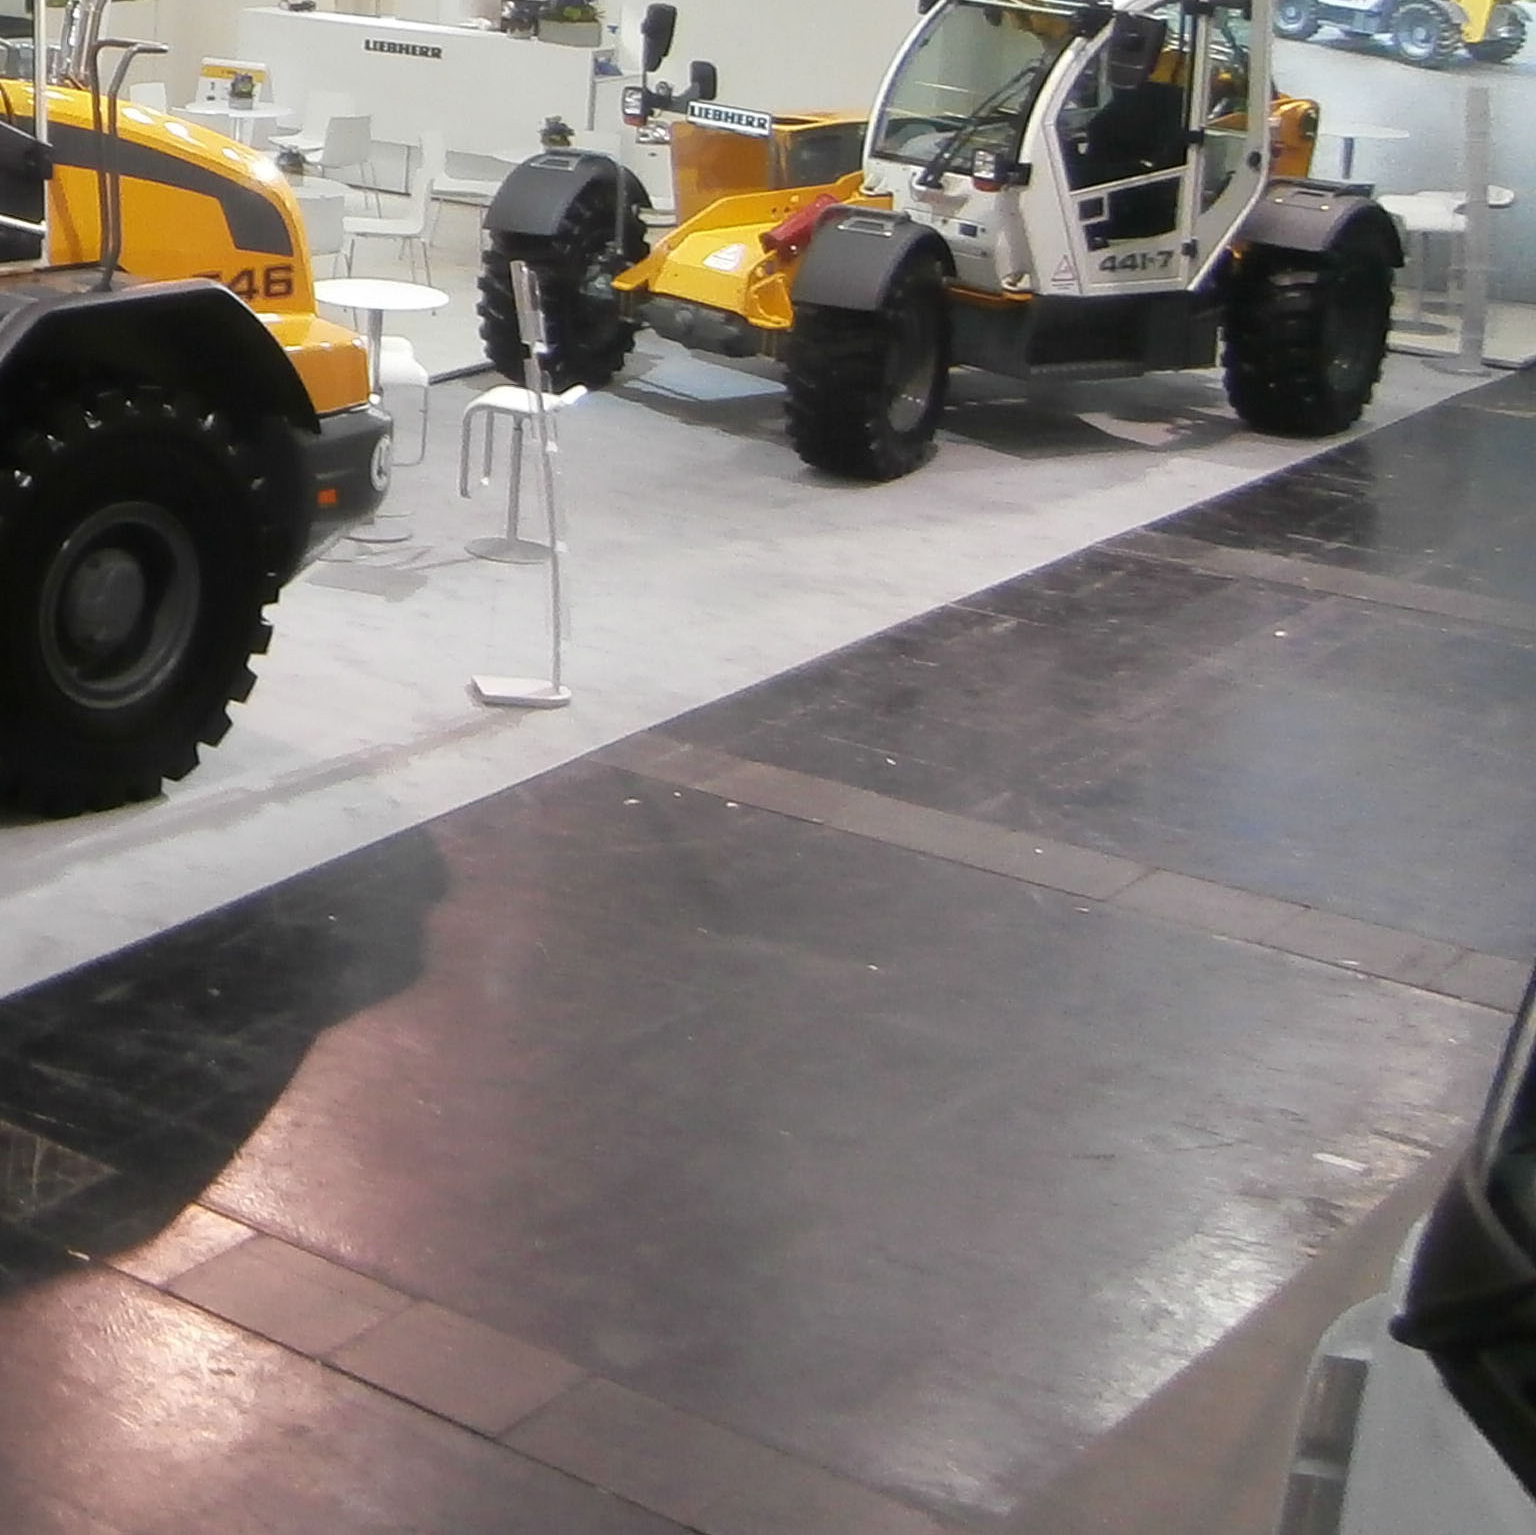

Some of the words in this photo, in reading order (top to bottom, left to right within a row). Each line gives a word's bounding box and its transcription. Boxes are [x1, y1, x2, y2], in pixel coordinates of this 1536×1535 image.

[364, 39, 443, 60] LIEBHERR
[690, 105, 768, 130] LIEBHERR
[190, 264, 294, 300] 46
